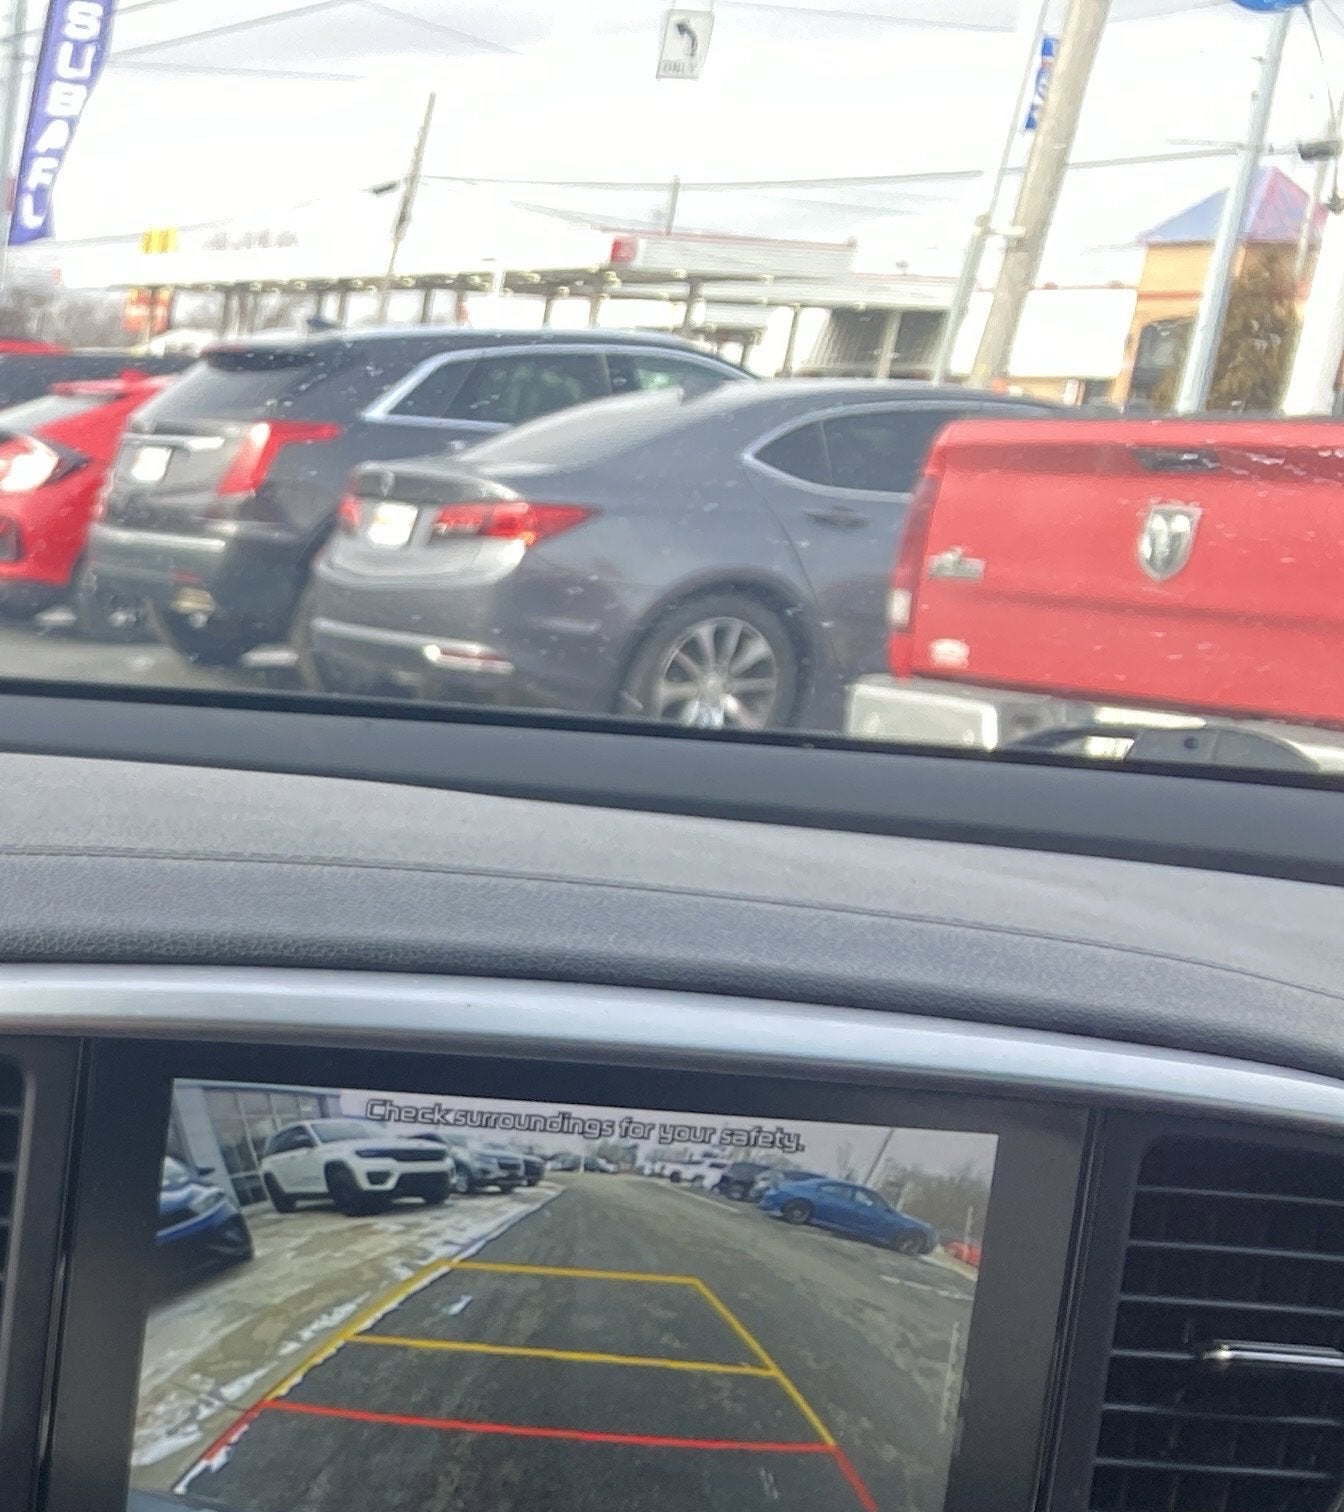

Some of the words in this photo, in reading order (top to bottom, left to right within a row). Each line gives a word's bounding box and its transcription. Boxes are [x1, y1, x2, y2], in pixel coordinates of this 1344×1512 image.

[365, 1099, 450, 1125] Check
[451, 1109, 613, 1139] surroundings
[619, 1118, 654, 1140] for
[658, 1121, 714, 1146] your
[718, 1127, 806, 1154] safety.
